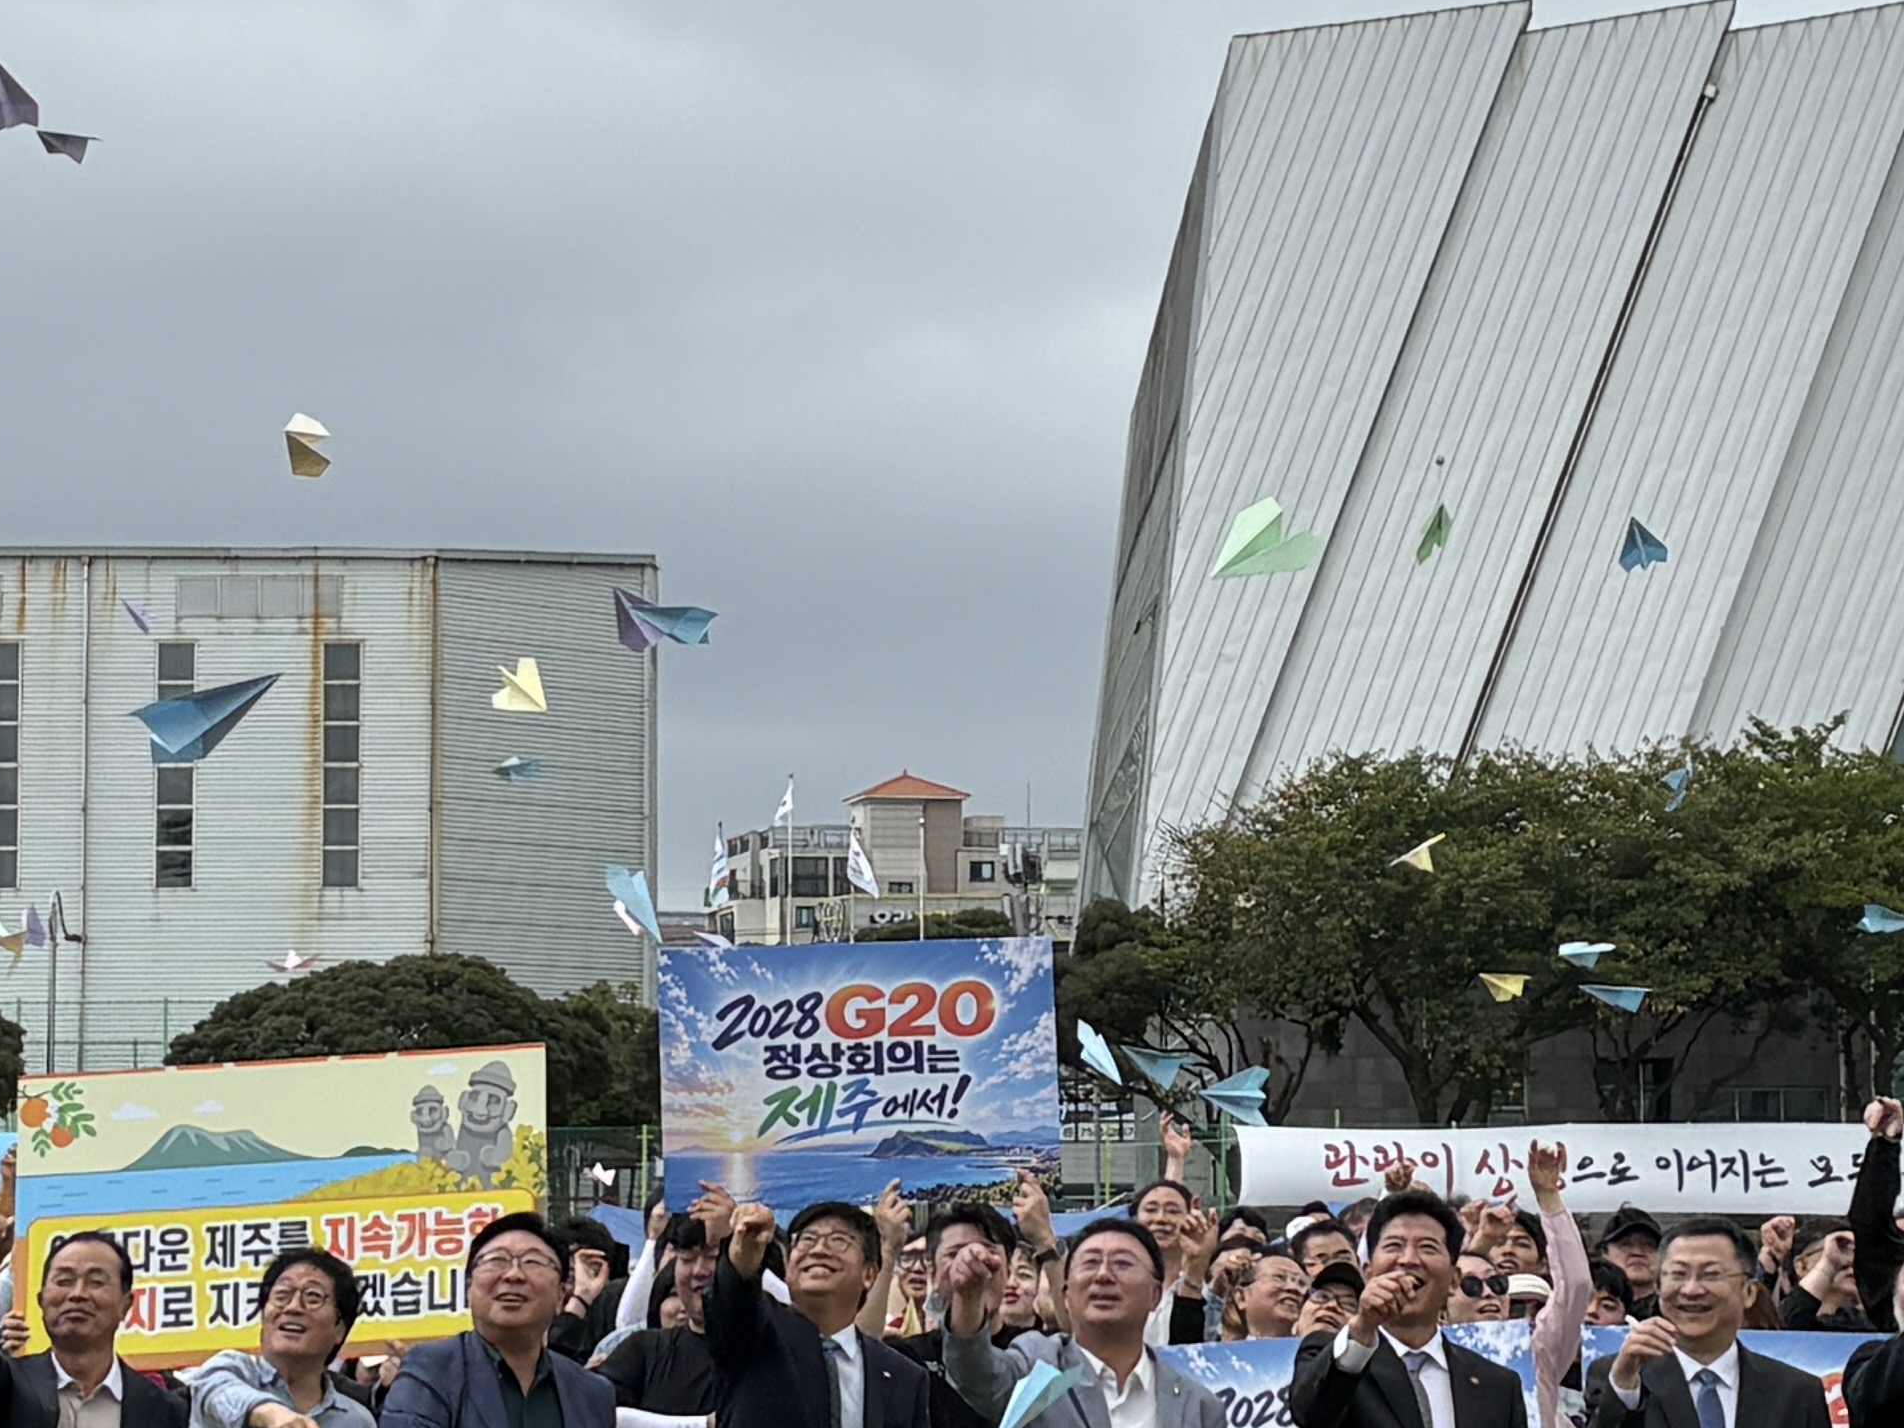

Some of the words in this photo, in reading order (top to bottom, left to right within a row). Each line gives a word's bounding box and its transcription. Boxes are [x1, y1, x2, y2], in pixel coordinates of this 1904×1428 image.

[711, 991, 824, 1052] 2028
[825, 980, 996, 1040] G20
[763, 1040, 961, 1080] 정상회의는
[1654, 1147, 1790, 1194] 이어지는
